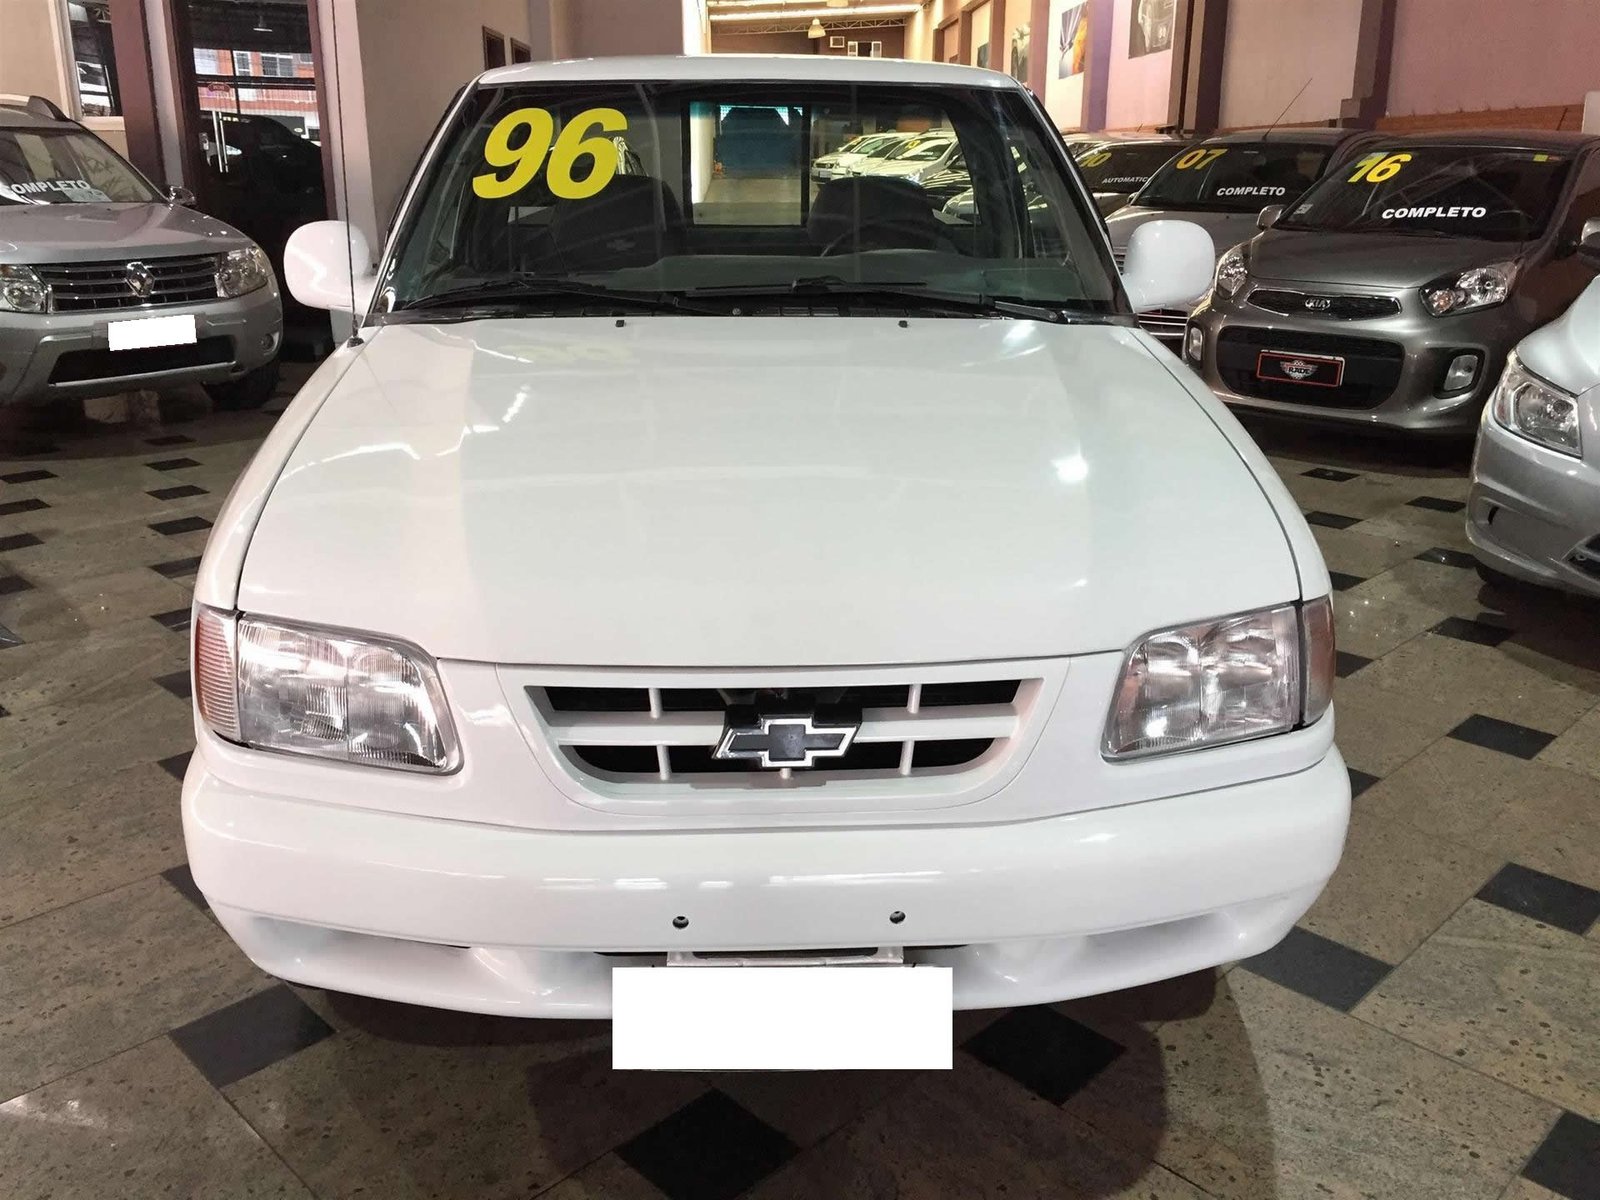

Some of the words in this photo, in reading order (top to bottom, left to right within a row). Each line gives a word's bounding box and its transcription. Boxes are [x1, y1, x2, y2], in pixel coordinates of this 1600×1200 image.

[472, 107, 628, 200] 96
[1176, 148, 1229, 170] 07
[1347, 152, 1412, 183] 16
[6, 180, 91, 195] OMPLETO
[1216, 186, 1286, 196] COMPLETO
[1381, 206, 1487, 219] COMPLETO
